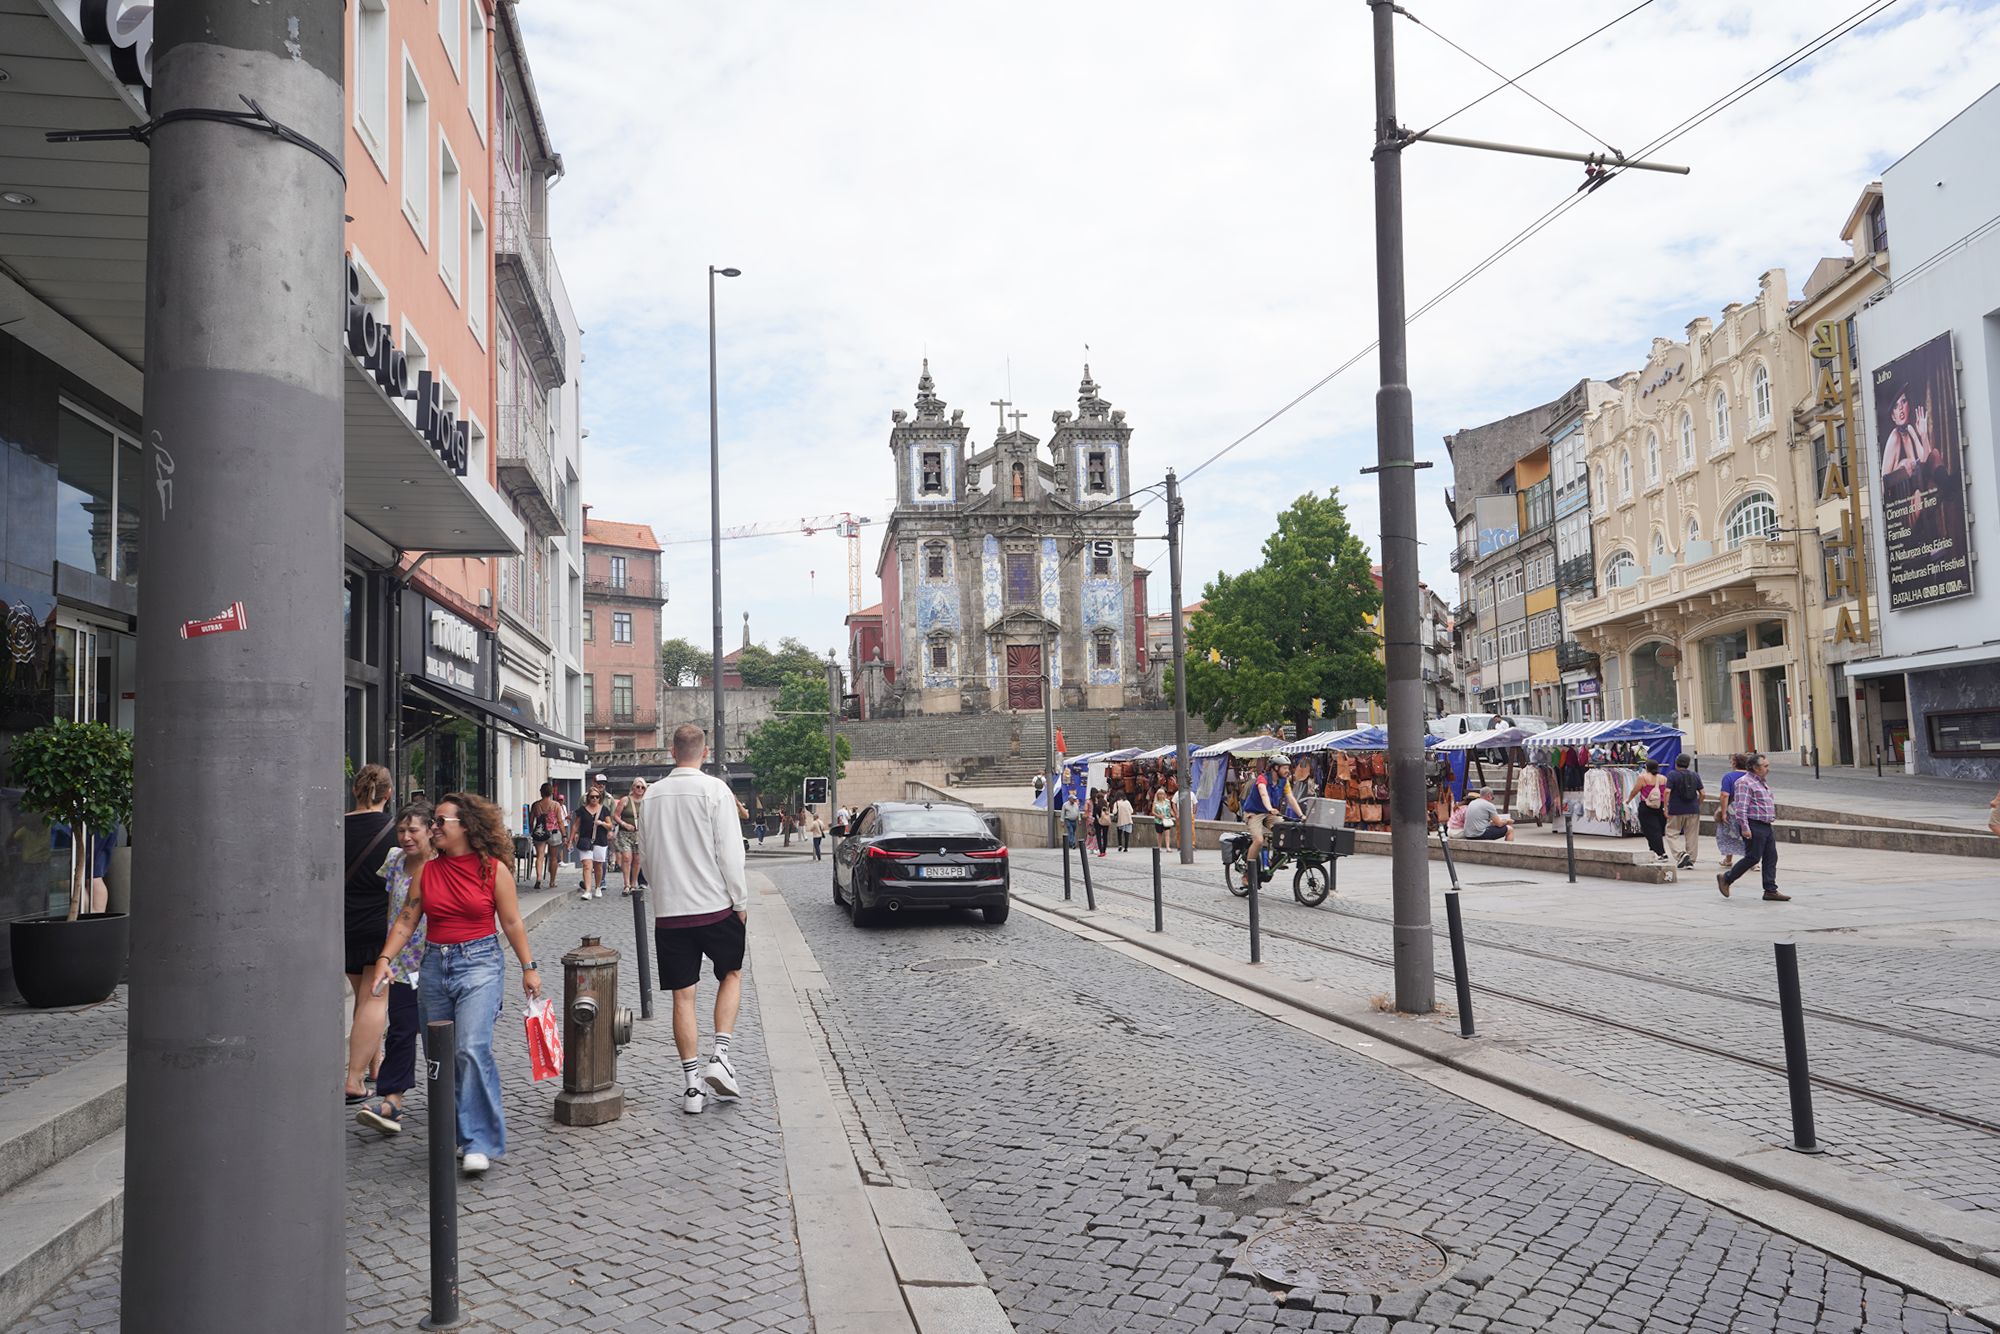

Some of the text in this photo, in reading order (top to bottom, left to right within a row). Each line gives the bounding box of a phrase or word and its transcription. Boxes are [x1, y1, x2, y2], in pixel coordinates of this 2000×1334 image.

[1876, 370, 1892, 385] Julho
[1886, 506, 1909, 520] Cinema
[1924, 496, 1937, 508] livre
[1094, 541, 1113, 557] S
[1890, 552, 1895, 562] A
[1895, 546, 1921, 561] Natureza
[1921, 542, 1933, 554] das
[1892, 555, 1966, 584] Arquiteturas Film Festival
[1893, 590, 1922, 605] BATALHA
[201, 623, 223, 633] ULTRAS
